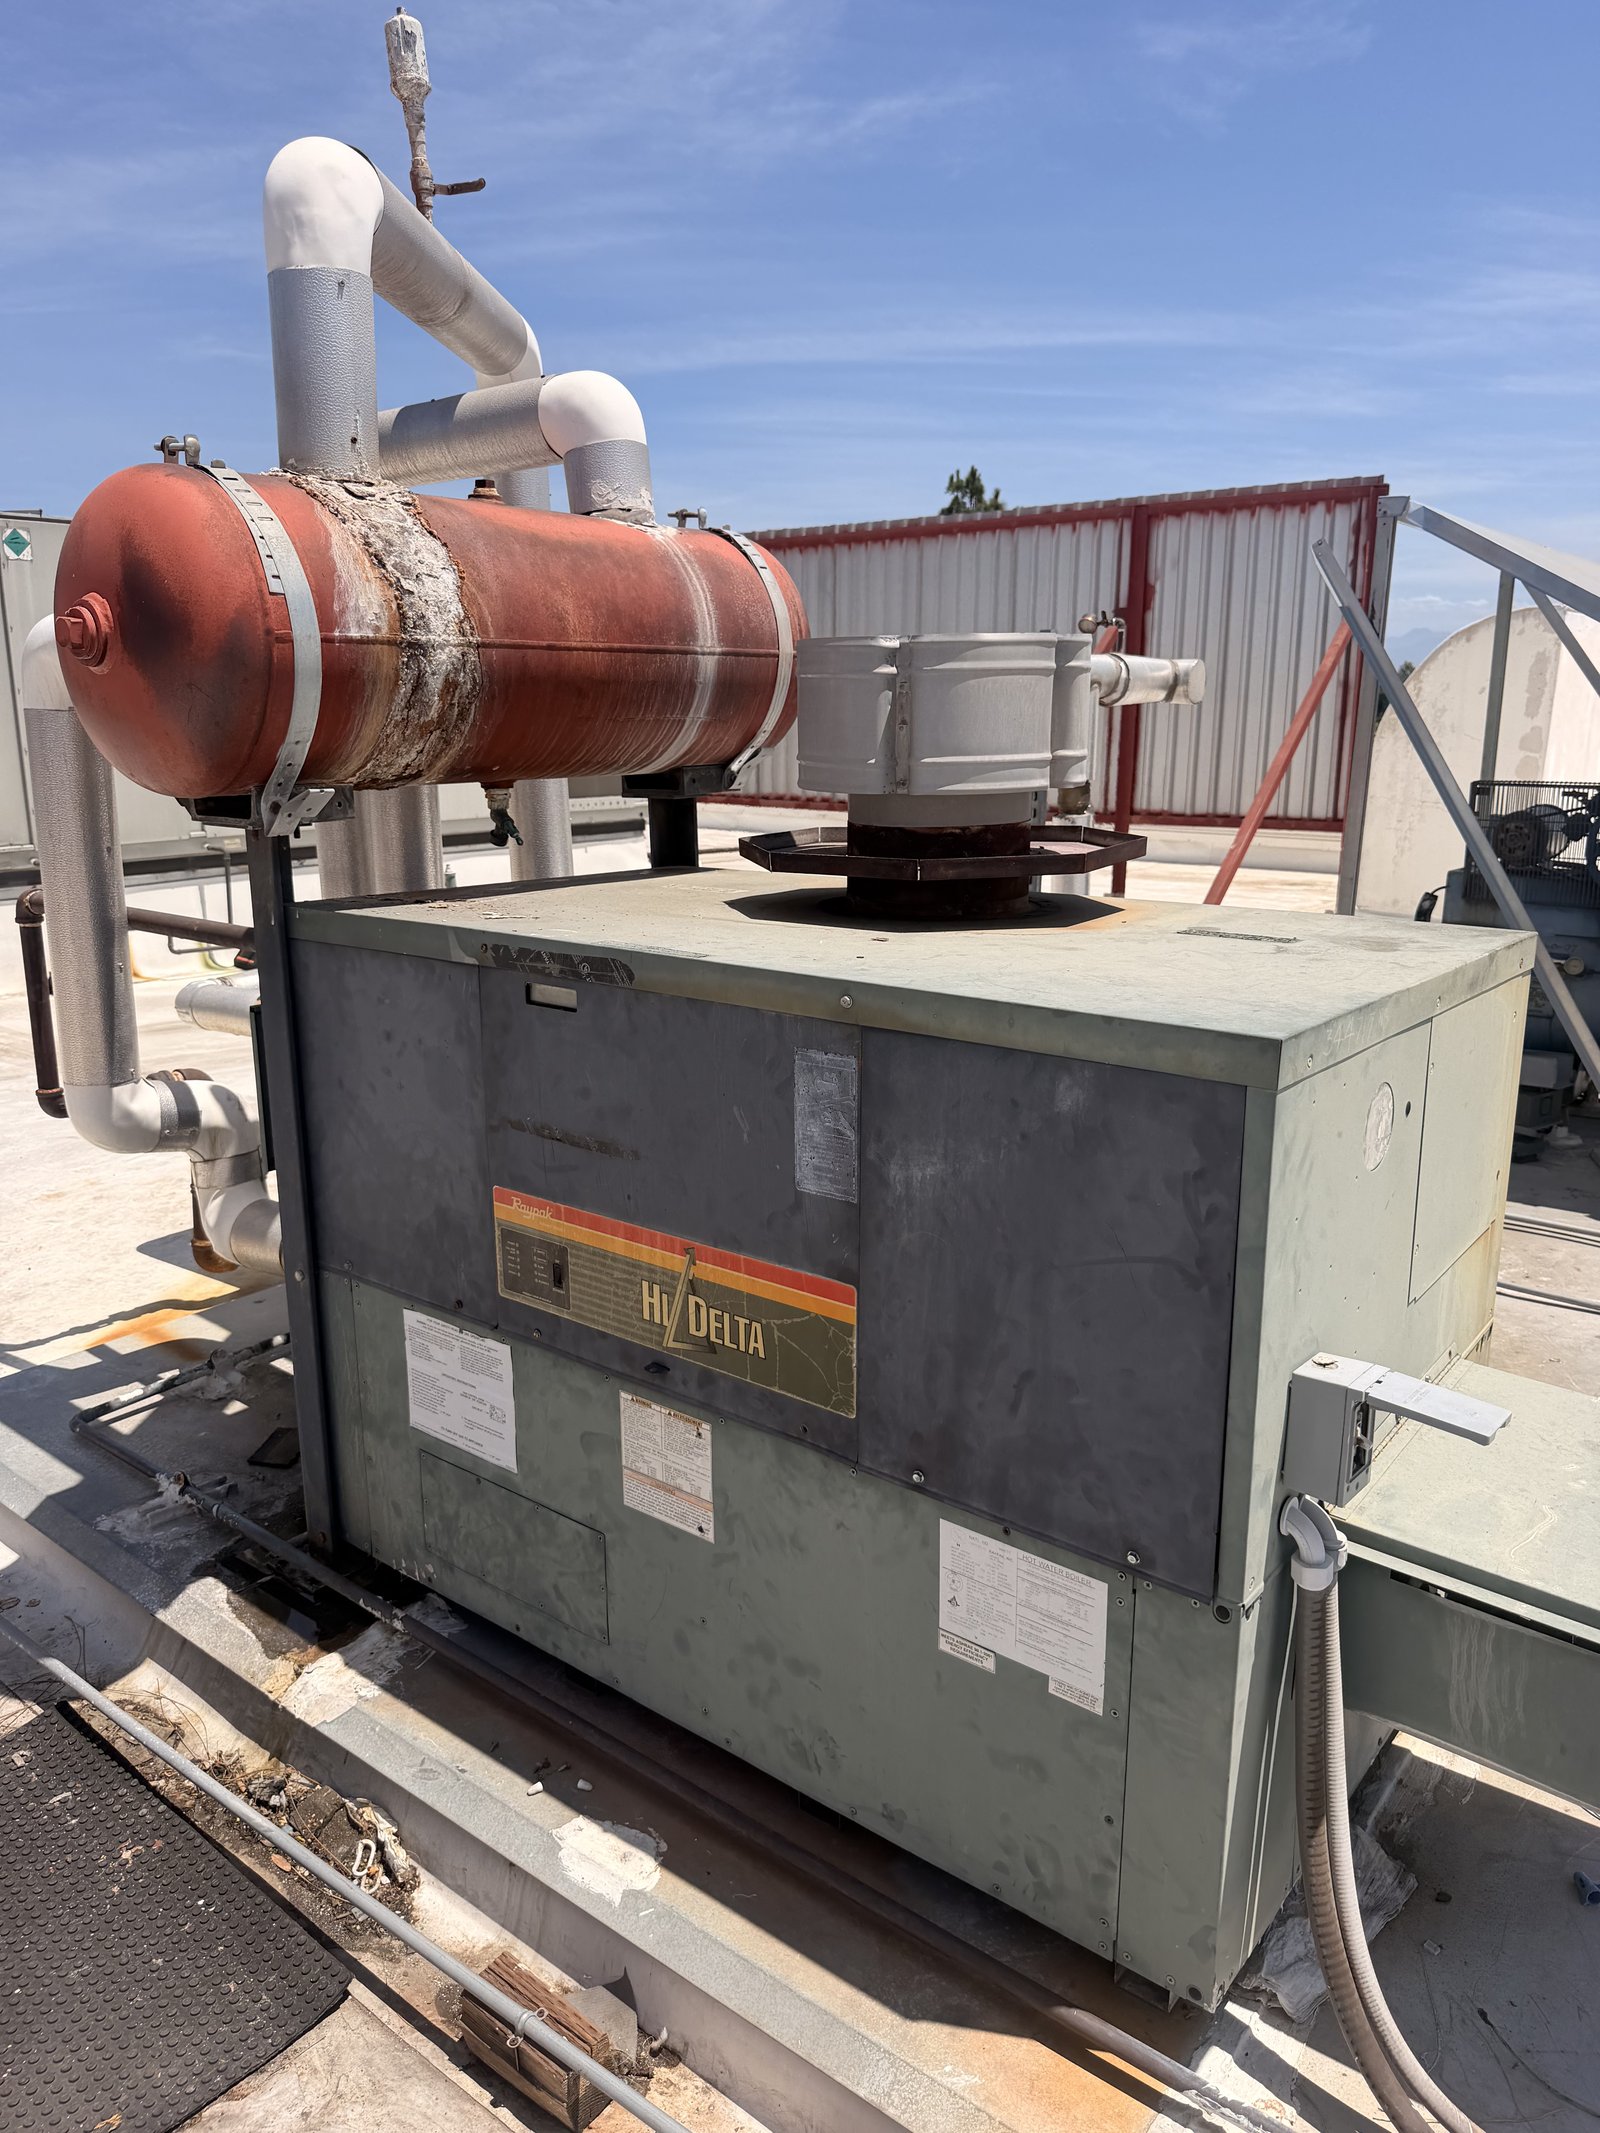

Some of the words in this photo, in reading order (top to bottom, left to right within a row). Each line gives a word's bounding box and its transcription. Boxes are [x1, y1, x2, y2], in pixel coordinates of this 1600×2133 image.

[511, 1196, 553, 1221] Raypak
[688, 1294, 767, 1360] DELTA
[1022, 1553, 1037, 1565] HOT
[1039, 1561, 1064, 1576] WATER
[1065, 1571, 1092, 1587] BOILER
